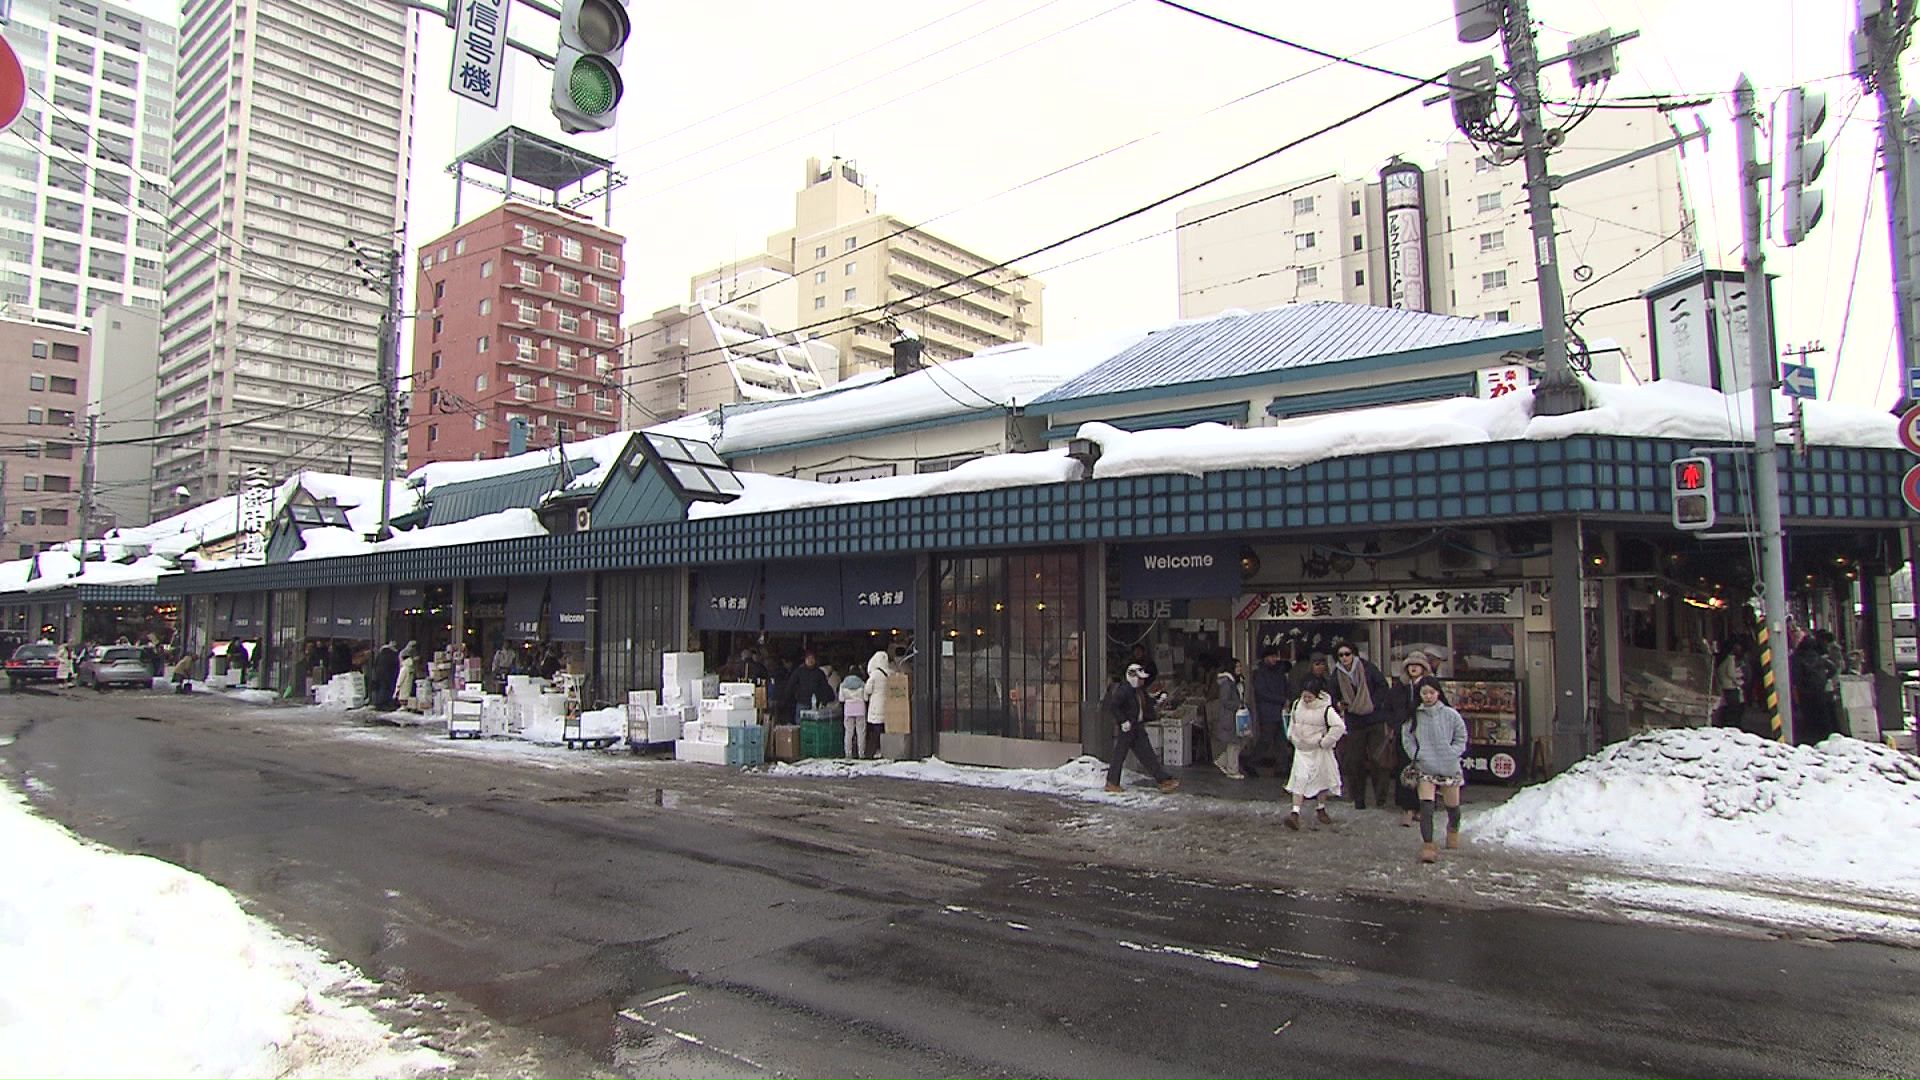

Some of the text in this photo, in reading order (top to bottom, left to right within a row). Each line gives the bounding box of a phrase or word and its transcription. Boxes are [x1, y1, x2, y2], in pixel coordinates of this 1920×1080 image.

[459, 0, 501, 97] 信号機
[1143, 555, 1213, 569] Welcome
[780, 605, 825, 617] Welcome
[559, 613, 585, 623] Welcome
